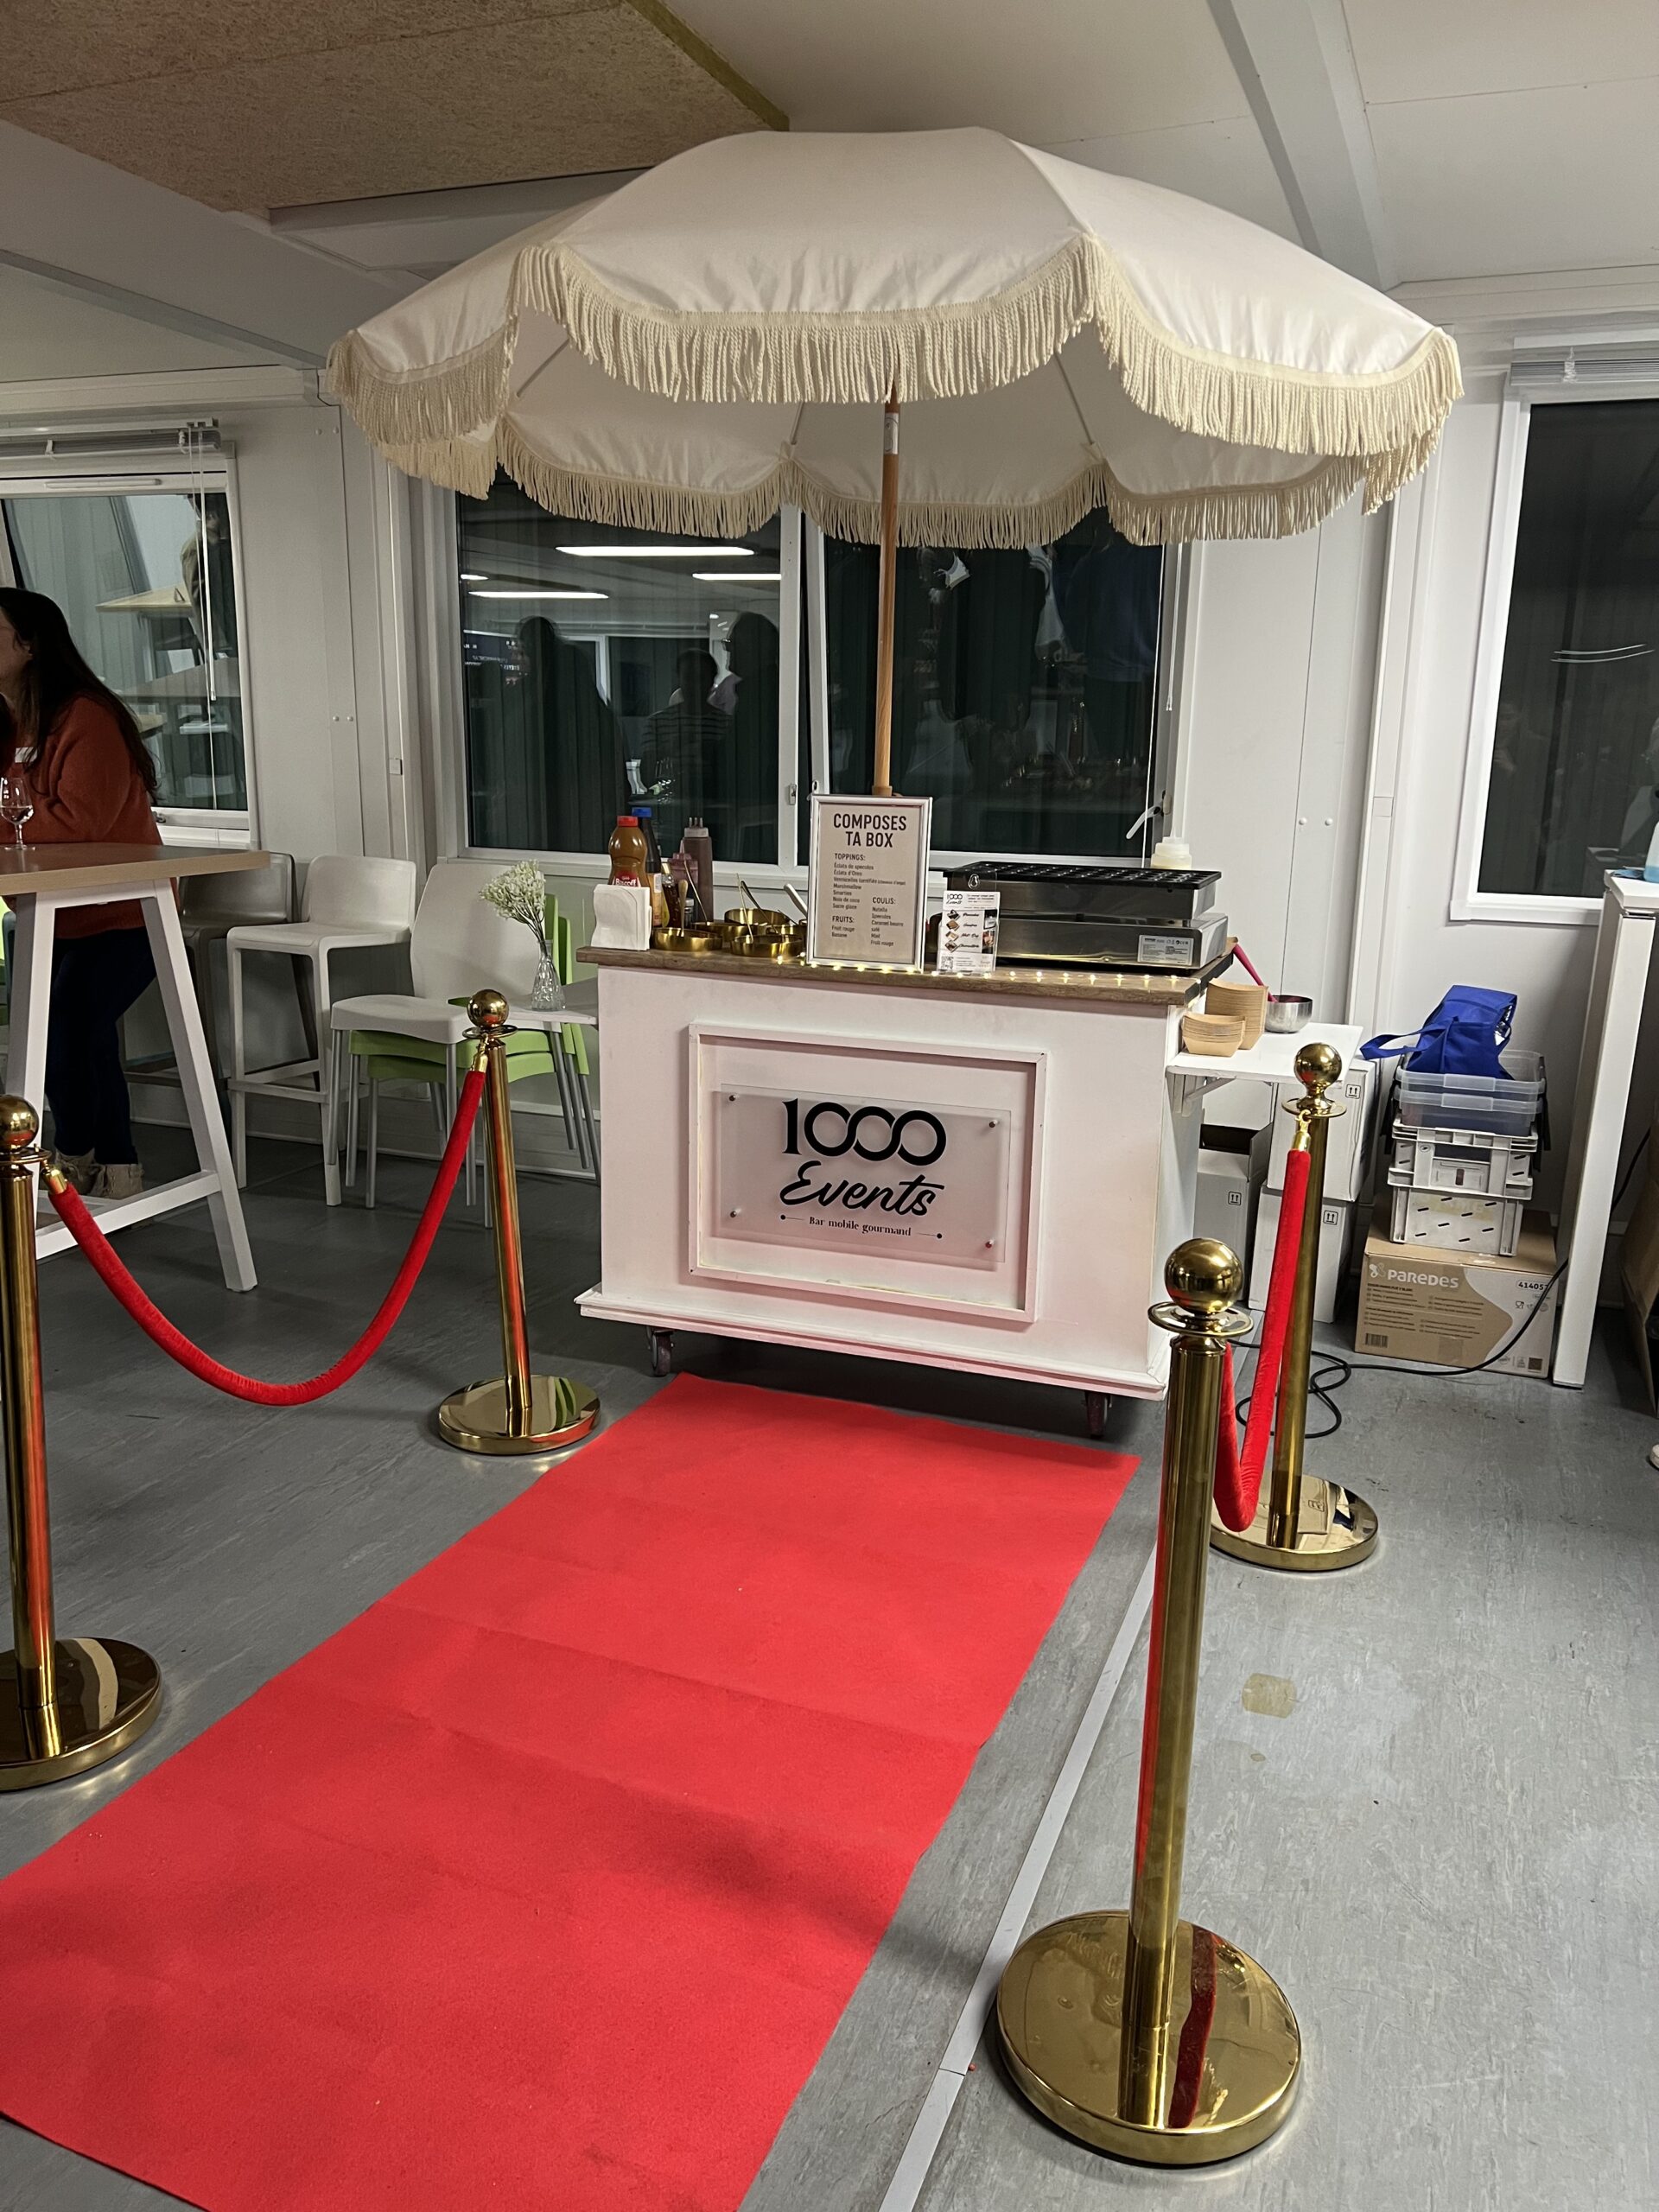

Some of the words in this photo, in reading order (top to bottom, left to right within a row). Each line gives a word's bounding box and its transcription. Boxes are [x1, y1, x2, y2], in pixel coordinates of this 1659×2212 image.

[833, 813, 907, 831] COMPOSES
[845, 830, 861, 847] TA
[866, 831, 893, 849] BOX
[834, 853, 866, 861] TOPPINGS:
[832, 915, 855, 924] FRUITS:
[781, 1097, 947, 1166] 1000
[779, 1160, 945, 1217] Events
[809, 1216, 825, 1226] Bar
[828, 1218, 860, 1230] mobile
[861, 1224, 912, 1236] gourmand
